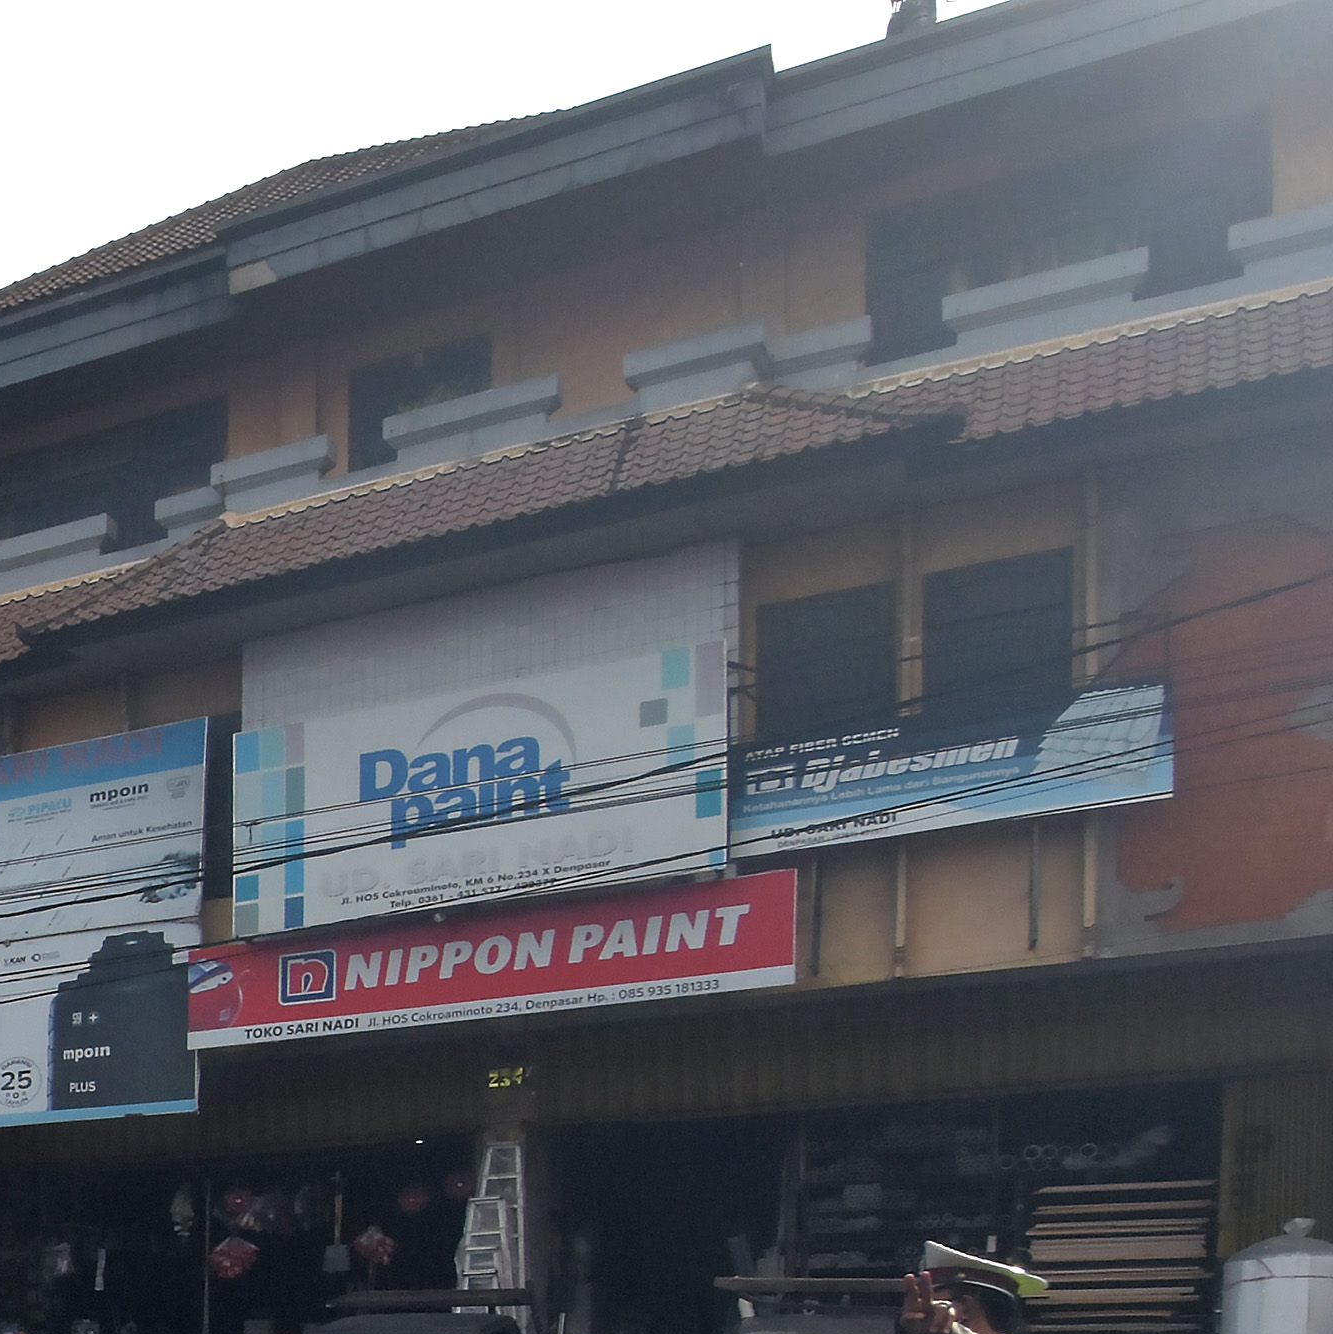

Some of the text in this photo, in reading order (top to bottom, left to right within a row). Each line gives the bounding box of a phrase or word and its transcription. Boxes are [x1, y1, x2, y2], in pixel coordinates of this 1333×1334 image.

[61, 728, 163, 773] NADI
[745, 746, 784, 762] ATAP
[359, 736, 541, 801] Dana
[90, 783, 149, 803] mpoin
[390, 754, 570, 849] paint
[743, 765, 1020, 813] Ketahanannya Lebih Lama dari Bangunannya
[91, 819, 193, 843] Aman untuk Kesehatan
[853, 811, 897, 830] NADI
[341, 859, 611, 906] Jl. HOS Cokroaminoto, KM 6 No.234 X Denpasar
[411, 851, 500, 886] SARI
[389, 899, 416, 911] Telp.
[418, 892, 445, 905] 0361
[343, 930, 555, 991] NIPPON
[568, 904, 751, 964] PAINT
[244, 1027, 283, 1039] TOKO
[286, 1023, 318, 1035] SARI
[323, 1018, 359, 1031] NADI
[367, 1017, 379, 1028] Jl.
[382, 1013, 408, 1026] HOS
[412, 1006, 493, 1023] Cokroaminoto
[496, 1001, 523, 1014] 234,
[526, 994, 584, 1011] Denpasar
[587, 992, 609, 1004] Hp.
[618, 988, 644, 999] 085
[648, 984, 671, 996] 935
[676, 979, 720, 993] 181333
[63, 1045, 111, 1062] mpoin
[0, 1070, 33, 1091] 25
[69, 1081, 96, 1093] PLUS
